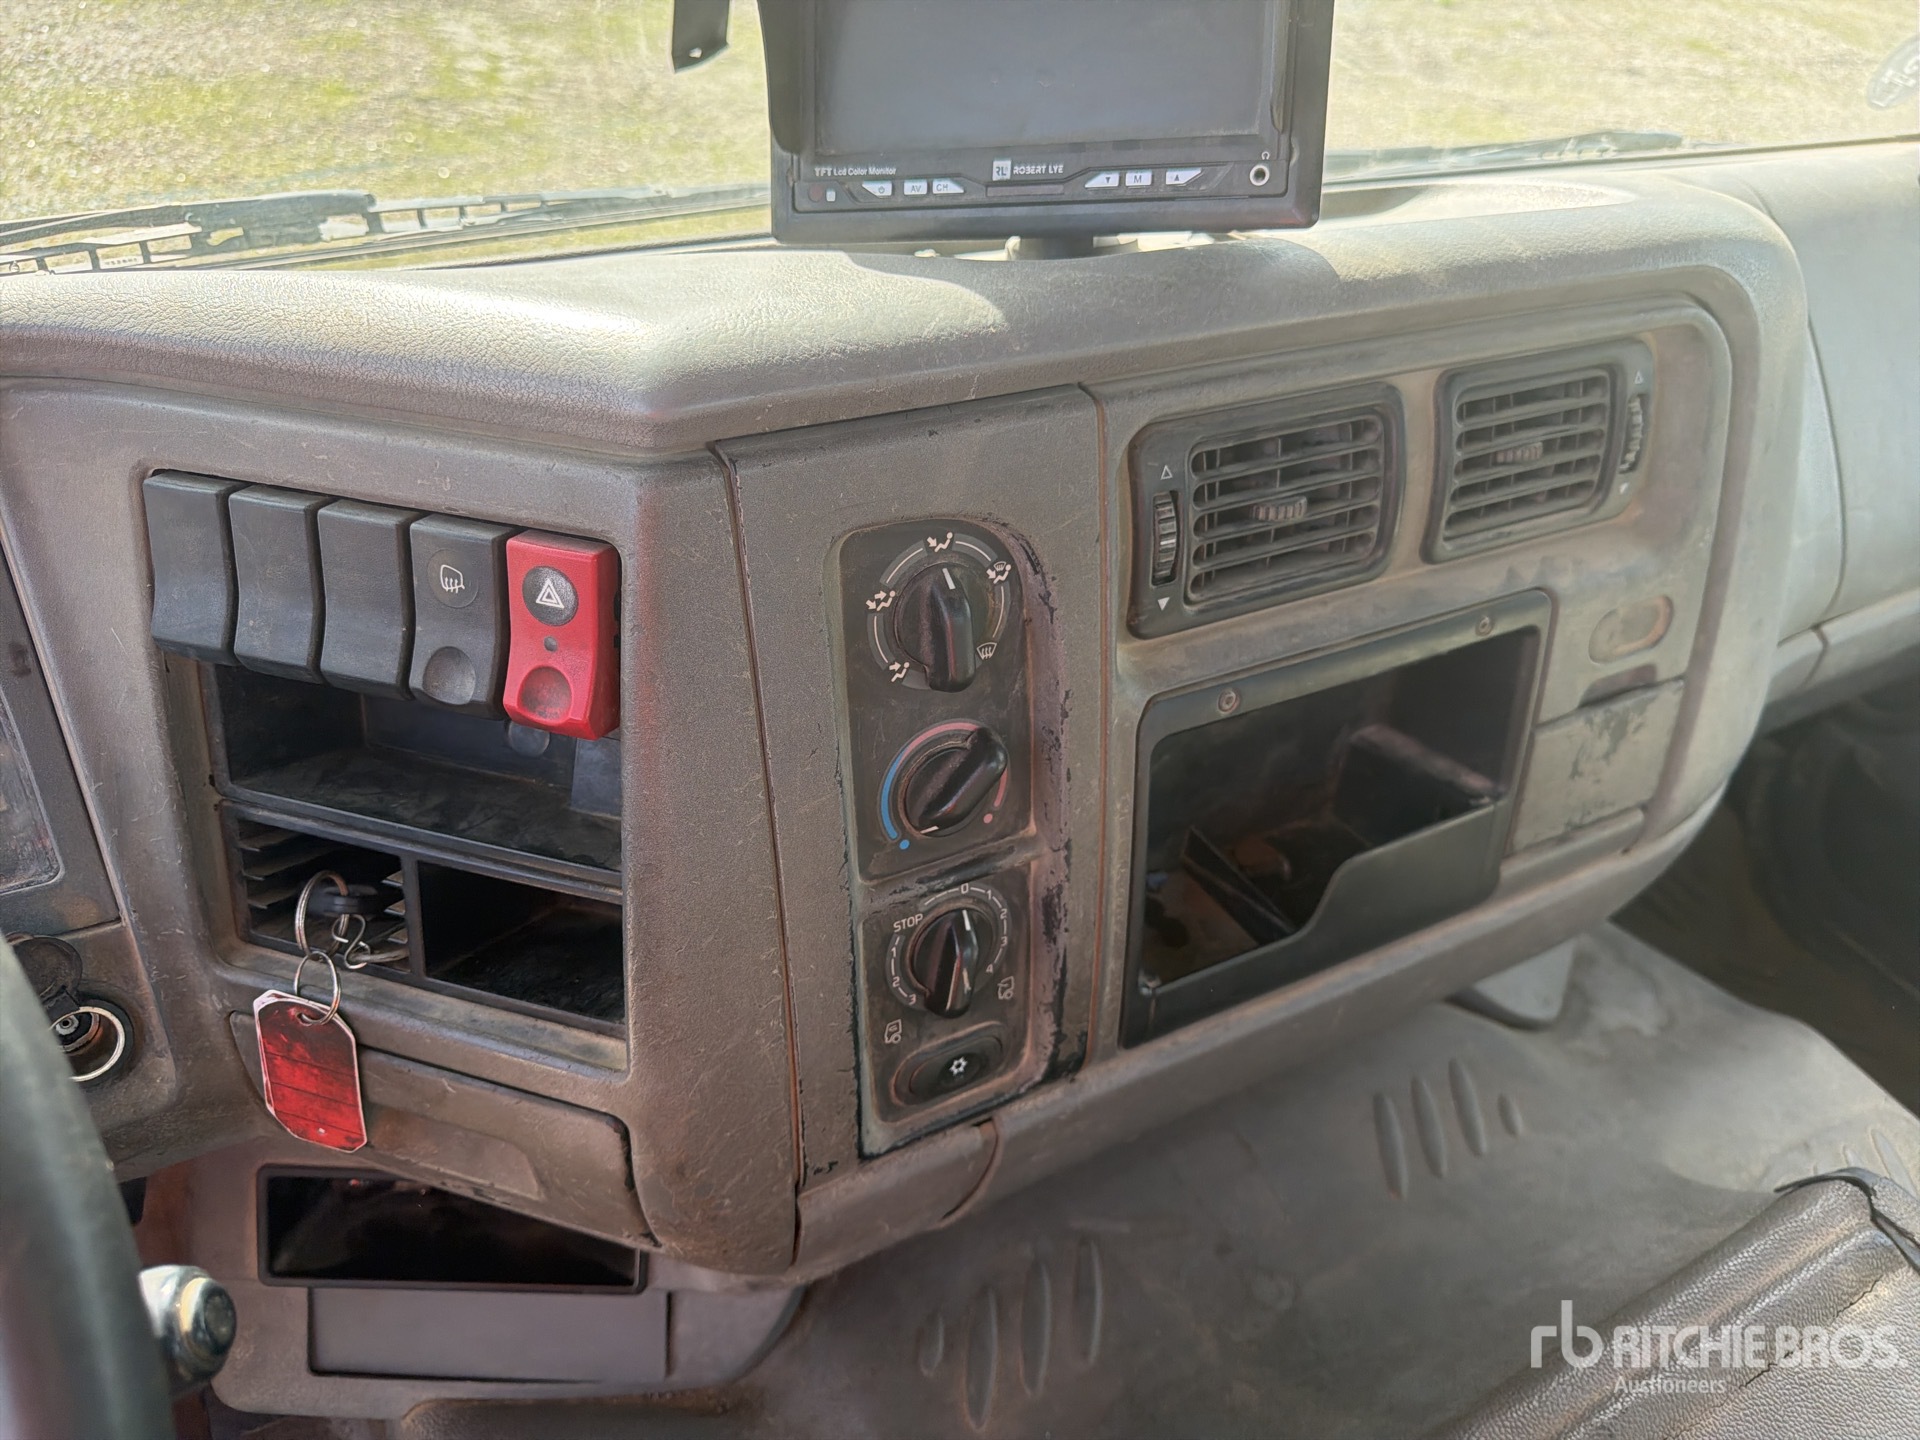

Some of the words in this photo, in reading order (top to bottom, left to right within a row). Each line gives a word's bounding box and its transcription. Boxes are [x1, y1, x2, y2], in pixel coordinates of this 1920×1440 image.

[814, 166, 832, 177] TFT
[848, 166, 867, 176] Color
[868, 166, 897, 175] Monitor
[1012, 165, 1047, 175] ROBERT
[1048, 164, 1064, 174] LYE
[1133, 174, 1143, 184] M
[910, 184, 922, 193] AV
[936, 183, 949, 192] CH
[986, 889, 993, 900] 1
[1000, 908, 1007, 920] 2
[893, 913, 924, 933] STOP
[1000, 935, 1008, 947] 3
[891, 946, 897, 958] 1
[986, 963, 994, 974] 4
[892, 977, 900, 989] 2
[908, 993, 916, 1005] 3
